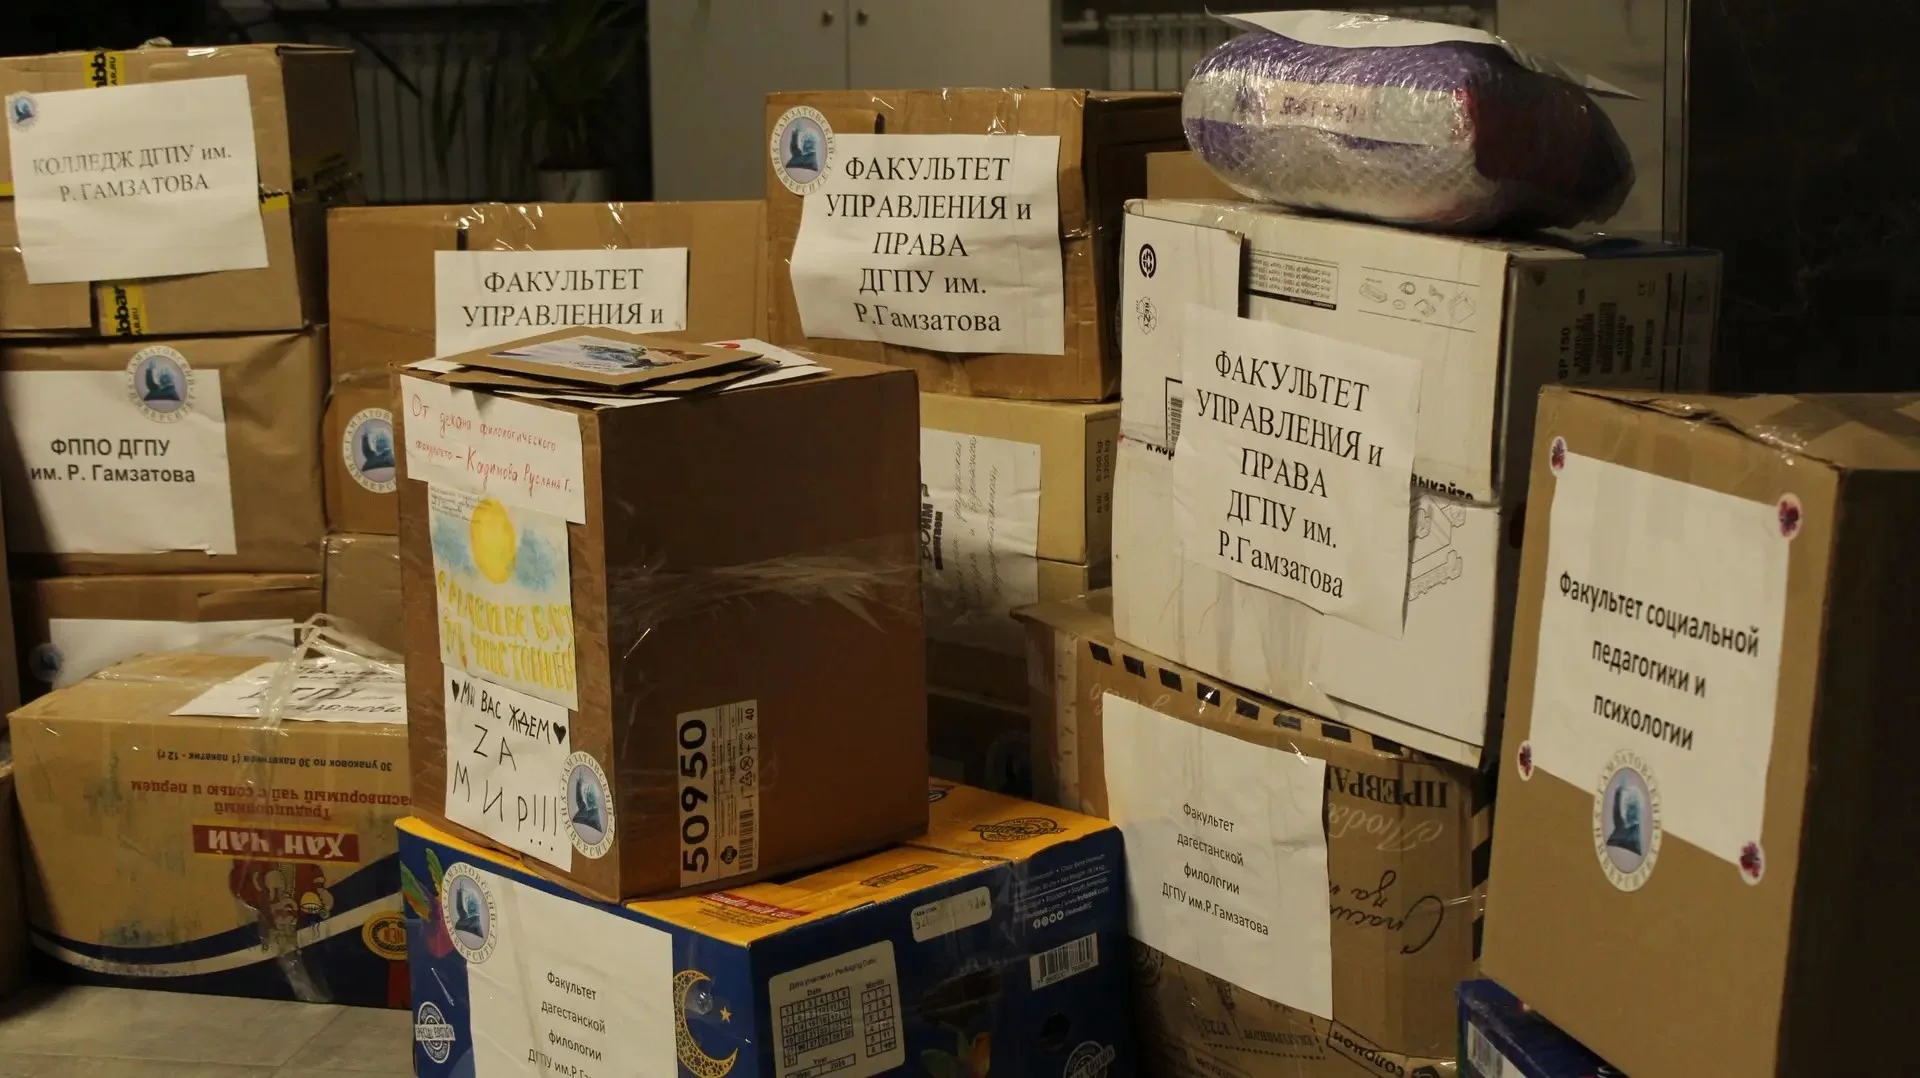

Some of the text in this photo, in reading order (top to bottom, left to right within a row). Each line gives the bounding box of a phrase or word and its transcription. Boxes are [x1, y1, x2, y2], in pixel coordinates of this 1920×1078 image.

[33, 145, 232, 175] КОЛЛЕДЖ ДГПУ им.
[845, 156, 1010, 181] ФАКУЛЬТЕТ
[826, 193, 1032, 220] УПРАВЛЕНИЯ и
[872, 232, 969, 257] ПРАВА
[484, 268, 644, 293] ФАКУЛЬТЕТ
[859, 267, 987, 296] ДГПУ им.
[462, 302, 664, 328] УПРАВЛЕНИЯ и
[853, 302, 1001, 332] Р.Гамзатова
[1215, 350, 1370, 413] ФАКУЛЬТЕТ
[412, 394, 431, 419] От
[439, 412, 472, 438] декана
[1196, 389, 1384, 467] УПРАВЛЕНИЯ и
[51, 438, 171, 458] ФППО ДГПУ
[31, 465, 195, 483] им. Р. Гамзатова
[1241, 448, 1328, 498] ПРАВА
[1227, 489, 1338, 548] ДГПУ им.
[1218, 529, 1344, 600] Р.Гамзатова
[1559, 570, 1760, 659] Факультет социальной
[1591, 638, 1706, 698] педагогики и
[481, 690, 502, 720] ВАС
[508, 704, 550, 744] ЖДЕМ
[746, 707, 756, 722] 40
[1592, 692, 1693, 752] психологии
[130, 779, 188, 794] перцем
[271, 788, 298, 804] чай
[679, 718, 710, 874] 50950
[1183, 802, 1235, 833] Факультет
[208, 829, 344, 858] ХАН ЧАЙ
[1177, 832, 1244, 866] дагестанской
[1162, 881, 1186, 905] ДГПУ
[1183, 862, 1240, 895] филологии
[547, 970, 597, 1001] Факультет
[541, 1000, 606, 1034] дагестанской
[528, 1048, 552, 1071] ДГПУ
[548, 1029, 602, 1062] филологии
